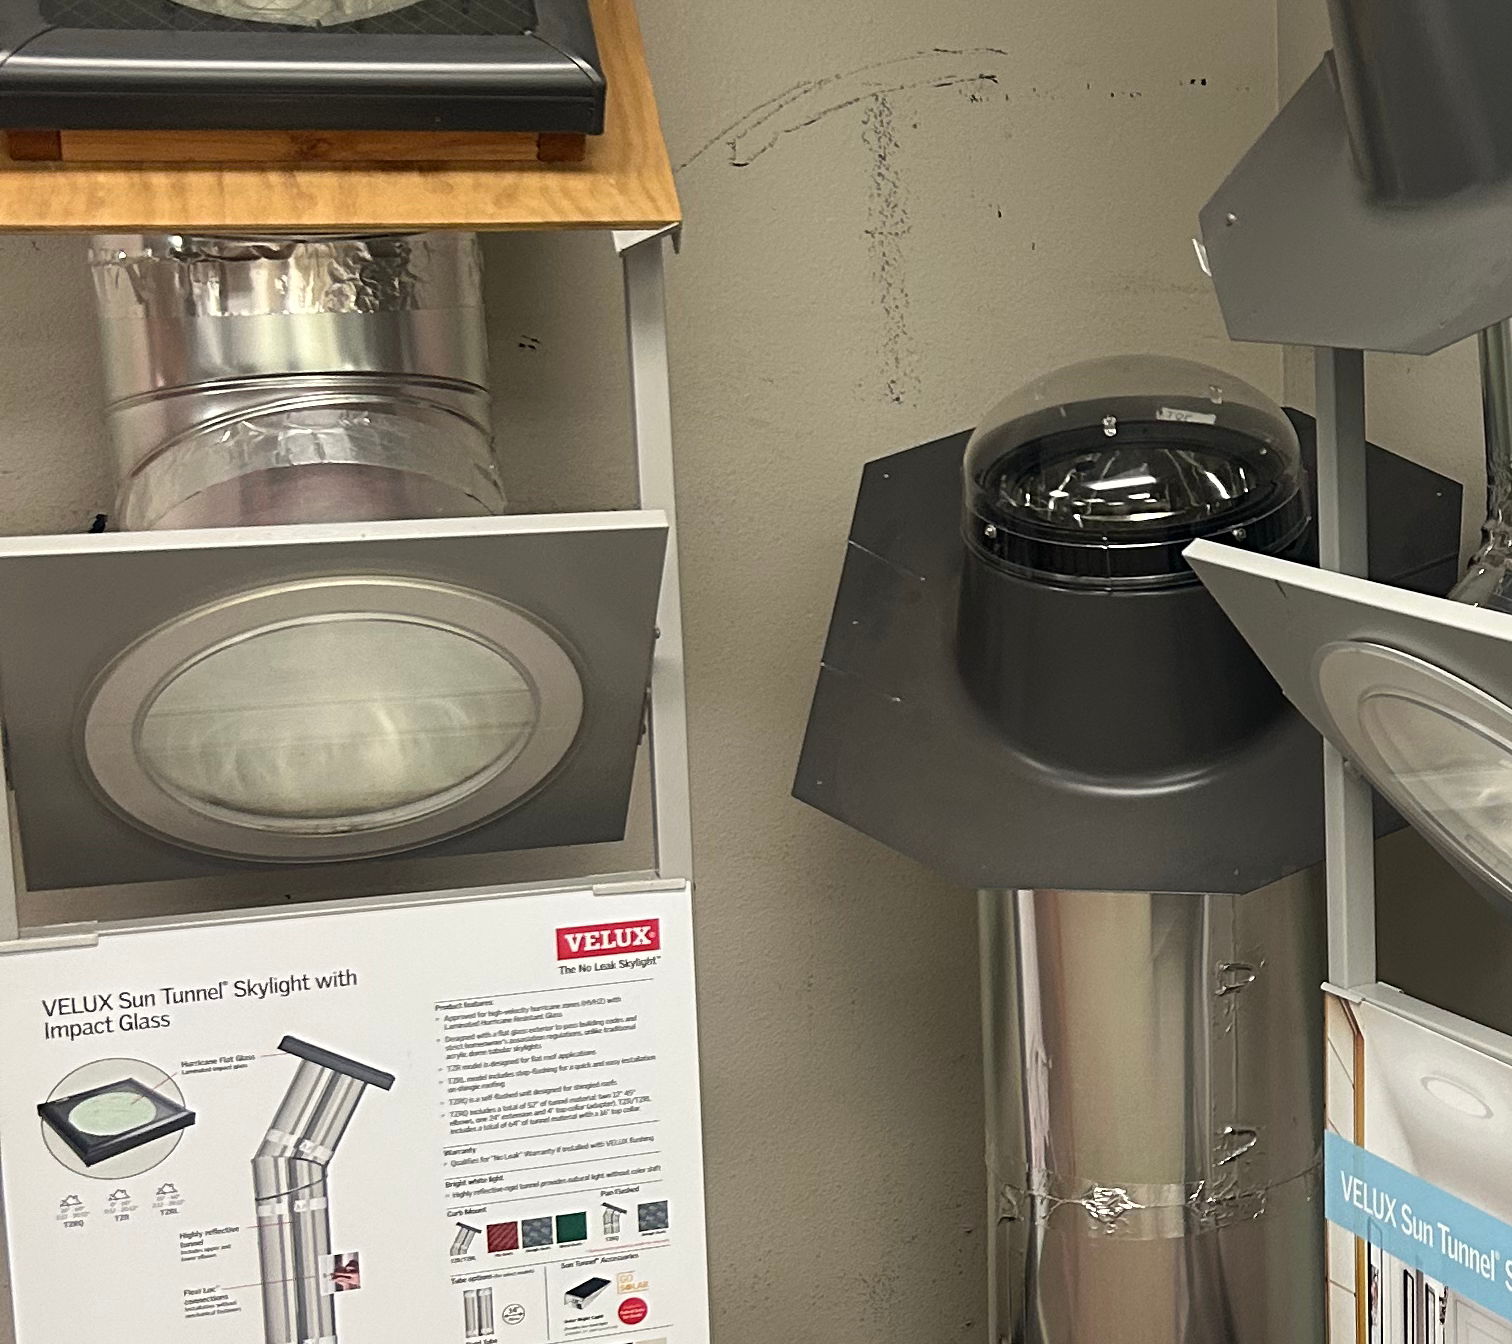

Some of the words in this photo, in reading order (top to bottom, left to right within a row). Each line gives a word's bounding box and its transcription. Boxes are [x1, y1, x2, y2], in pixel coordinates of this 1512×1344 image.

[564, 926, 652, 953] VELUX
[558, 965, 577, 975] The
[578, 963, 592, 973] No
[594, 960, 616, 972] Leak
[618, 956, 658, 969] Skylight
[42, 994, 114, 1017] VELUX
[119, 992, 156, 1010] Sun
[234, 974, 311, 1000] Skylight
[314, 969, 359, 988] with
[45, 1015, 115, 1041] Impact
[119, 1011, 171, 1032] Glass
[1340, 1170, 1398, 1228] VELUX
[1401, 1203, 1434, 1248] Sun
[180, 1231, 203, 1240] Highly
[205, 1227, 240, 1236] reflective
[619, 1274, 633, 1284] GO
[184, 1294, 229, 1306] connections
